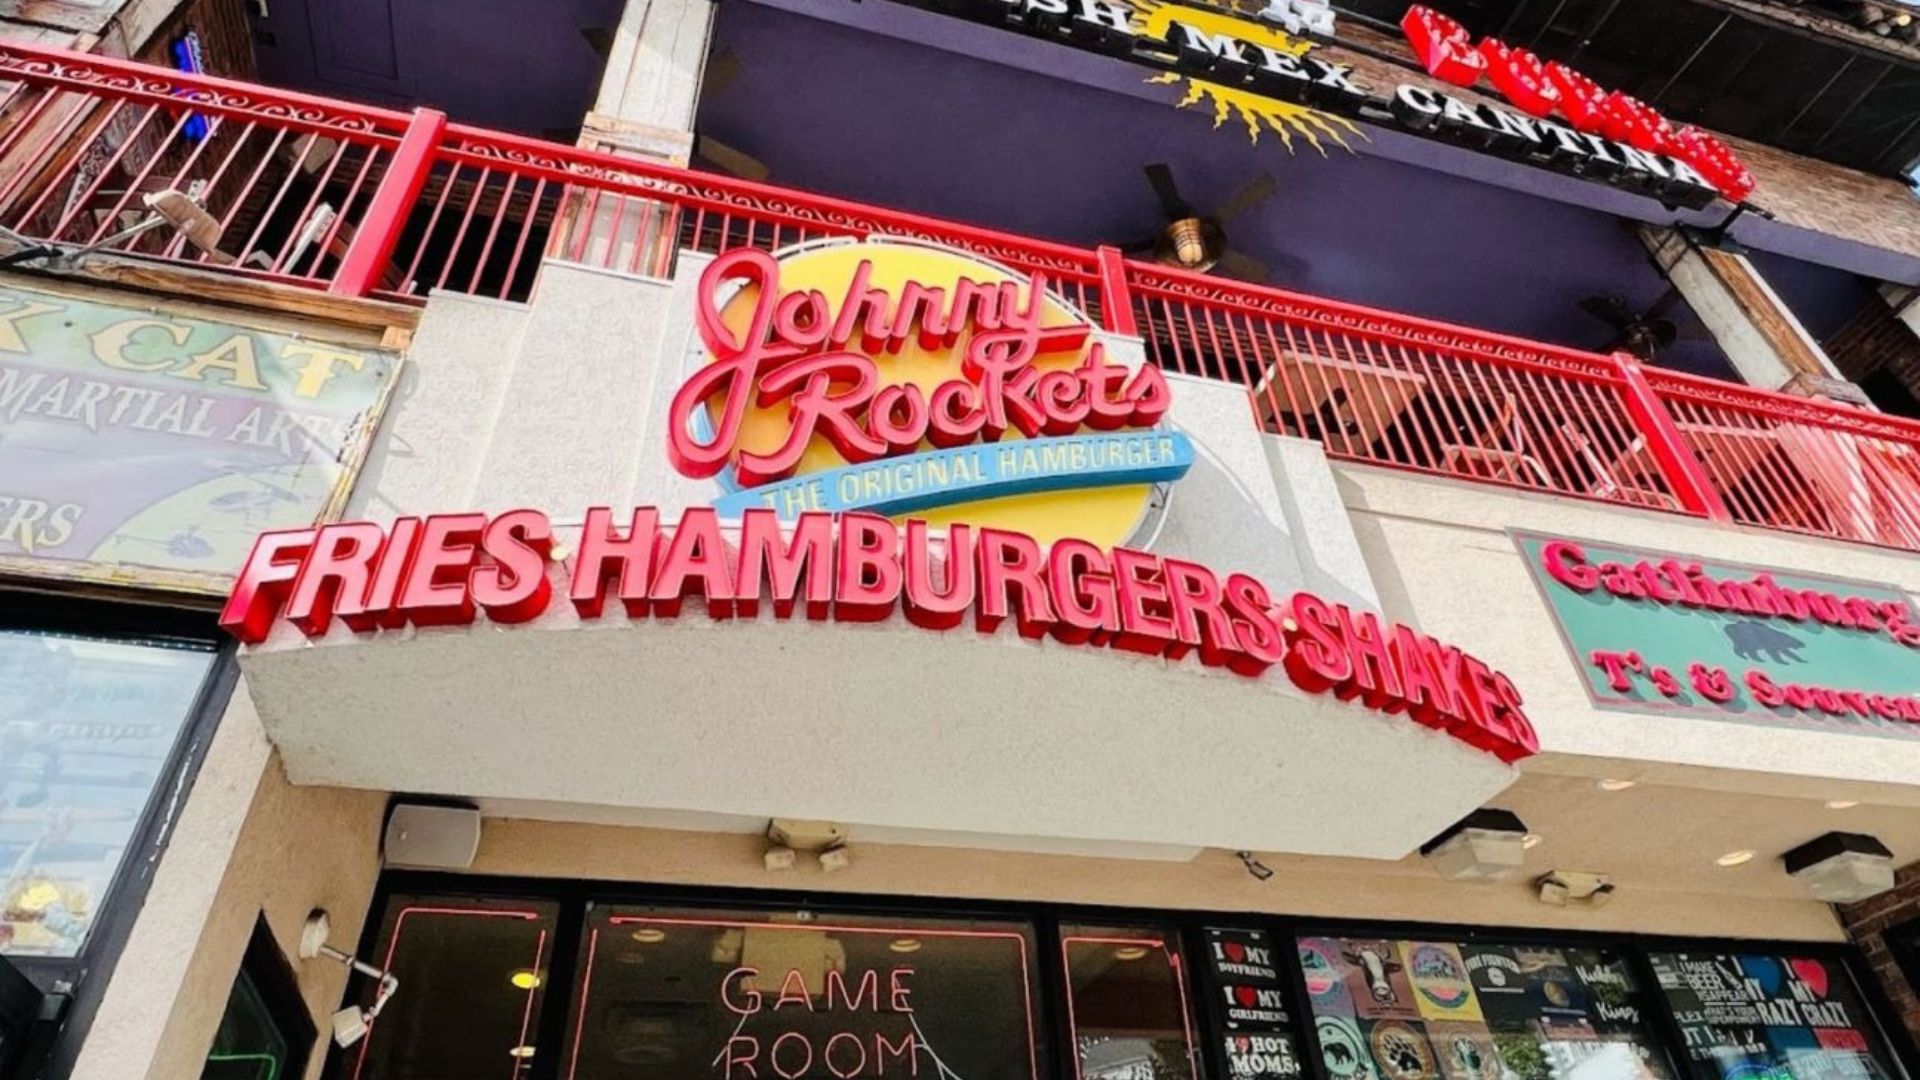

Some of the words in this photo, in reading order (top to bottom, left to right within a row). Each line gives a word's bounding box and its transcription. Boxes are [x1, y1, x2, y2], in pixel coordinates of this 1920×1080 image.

[1179, 24, 1372, 95] MEX
[1394, 83, 1720, 193] CANTINA
[90, 318, 364, 398] CAT
[668, 246, 1091, 480] Johnny
[0, 368, 214, 438] MARTIAL
[736, 338, 1174, 488] Rockets
[760, 477, 829, 520] THE
[837, 450, 989, 506] ORIGINAL
[998, 433, 1177, 483] HAMBURGER
[219, 508, 553, 644] FRIES
[569, 505, 1286, 677] HAMBURGERS
[1283, 590, 1541, 763] SHAKES
[1687, 662, 1736, 701] &
[1212, 942, 1225, 959] I
[1245, 946, 1270, 965] MY
[1218, 962, 1276, 978] BOYFRIEND
[720, 967, 916, 1014] GAME
[1223, 986, 1236, 1004] I
[1257, 990, 1281, 1007] MY
[1685, 973, 1726, 990] BEER
[1786, 979, 1817, 1003] MY
[1229, 1009, 1288, 1021] GIRLFRIEND
[1755, 998, 1802, 1026] RAZY
[1800, 1002, 1852, 1027] CRAZY
[724, 1031, 920, 1080] ROOM
[1250, 1037, 1290, 1053] HOT
